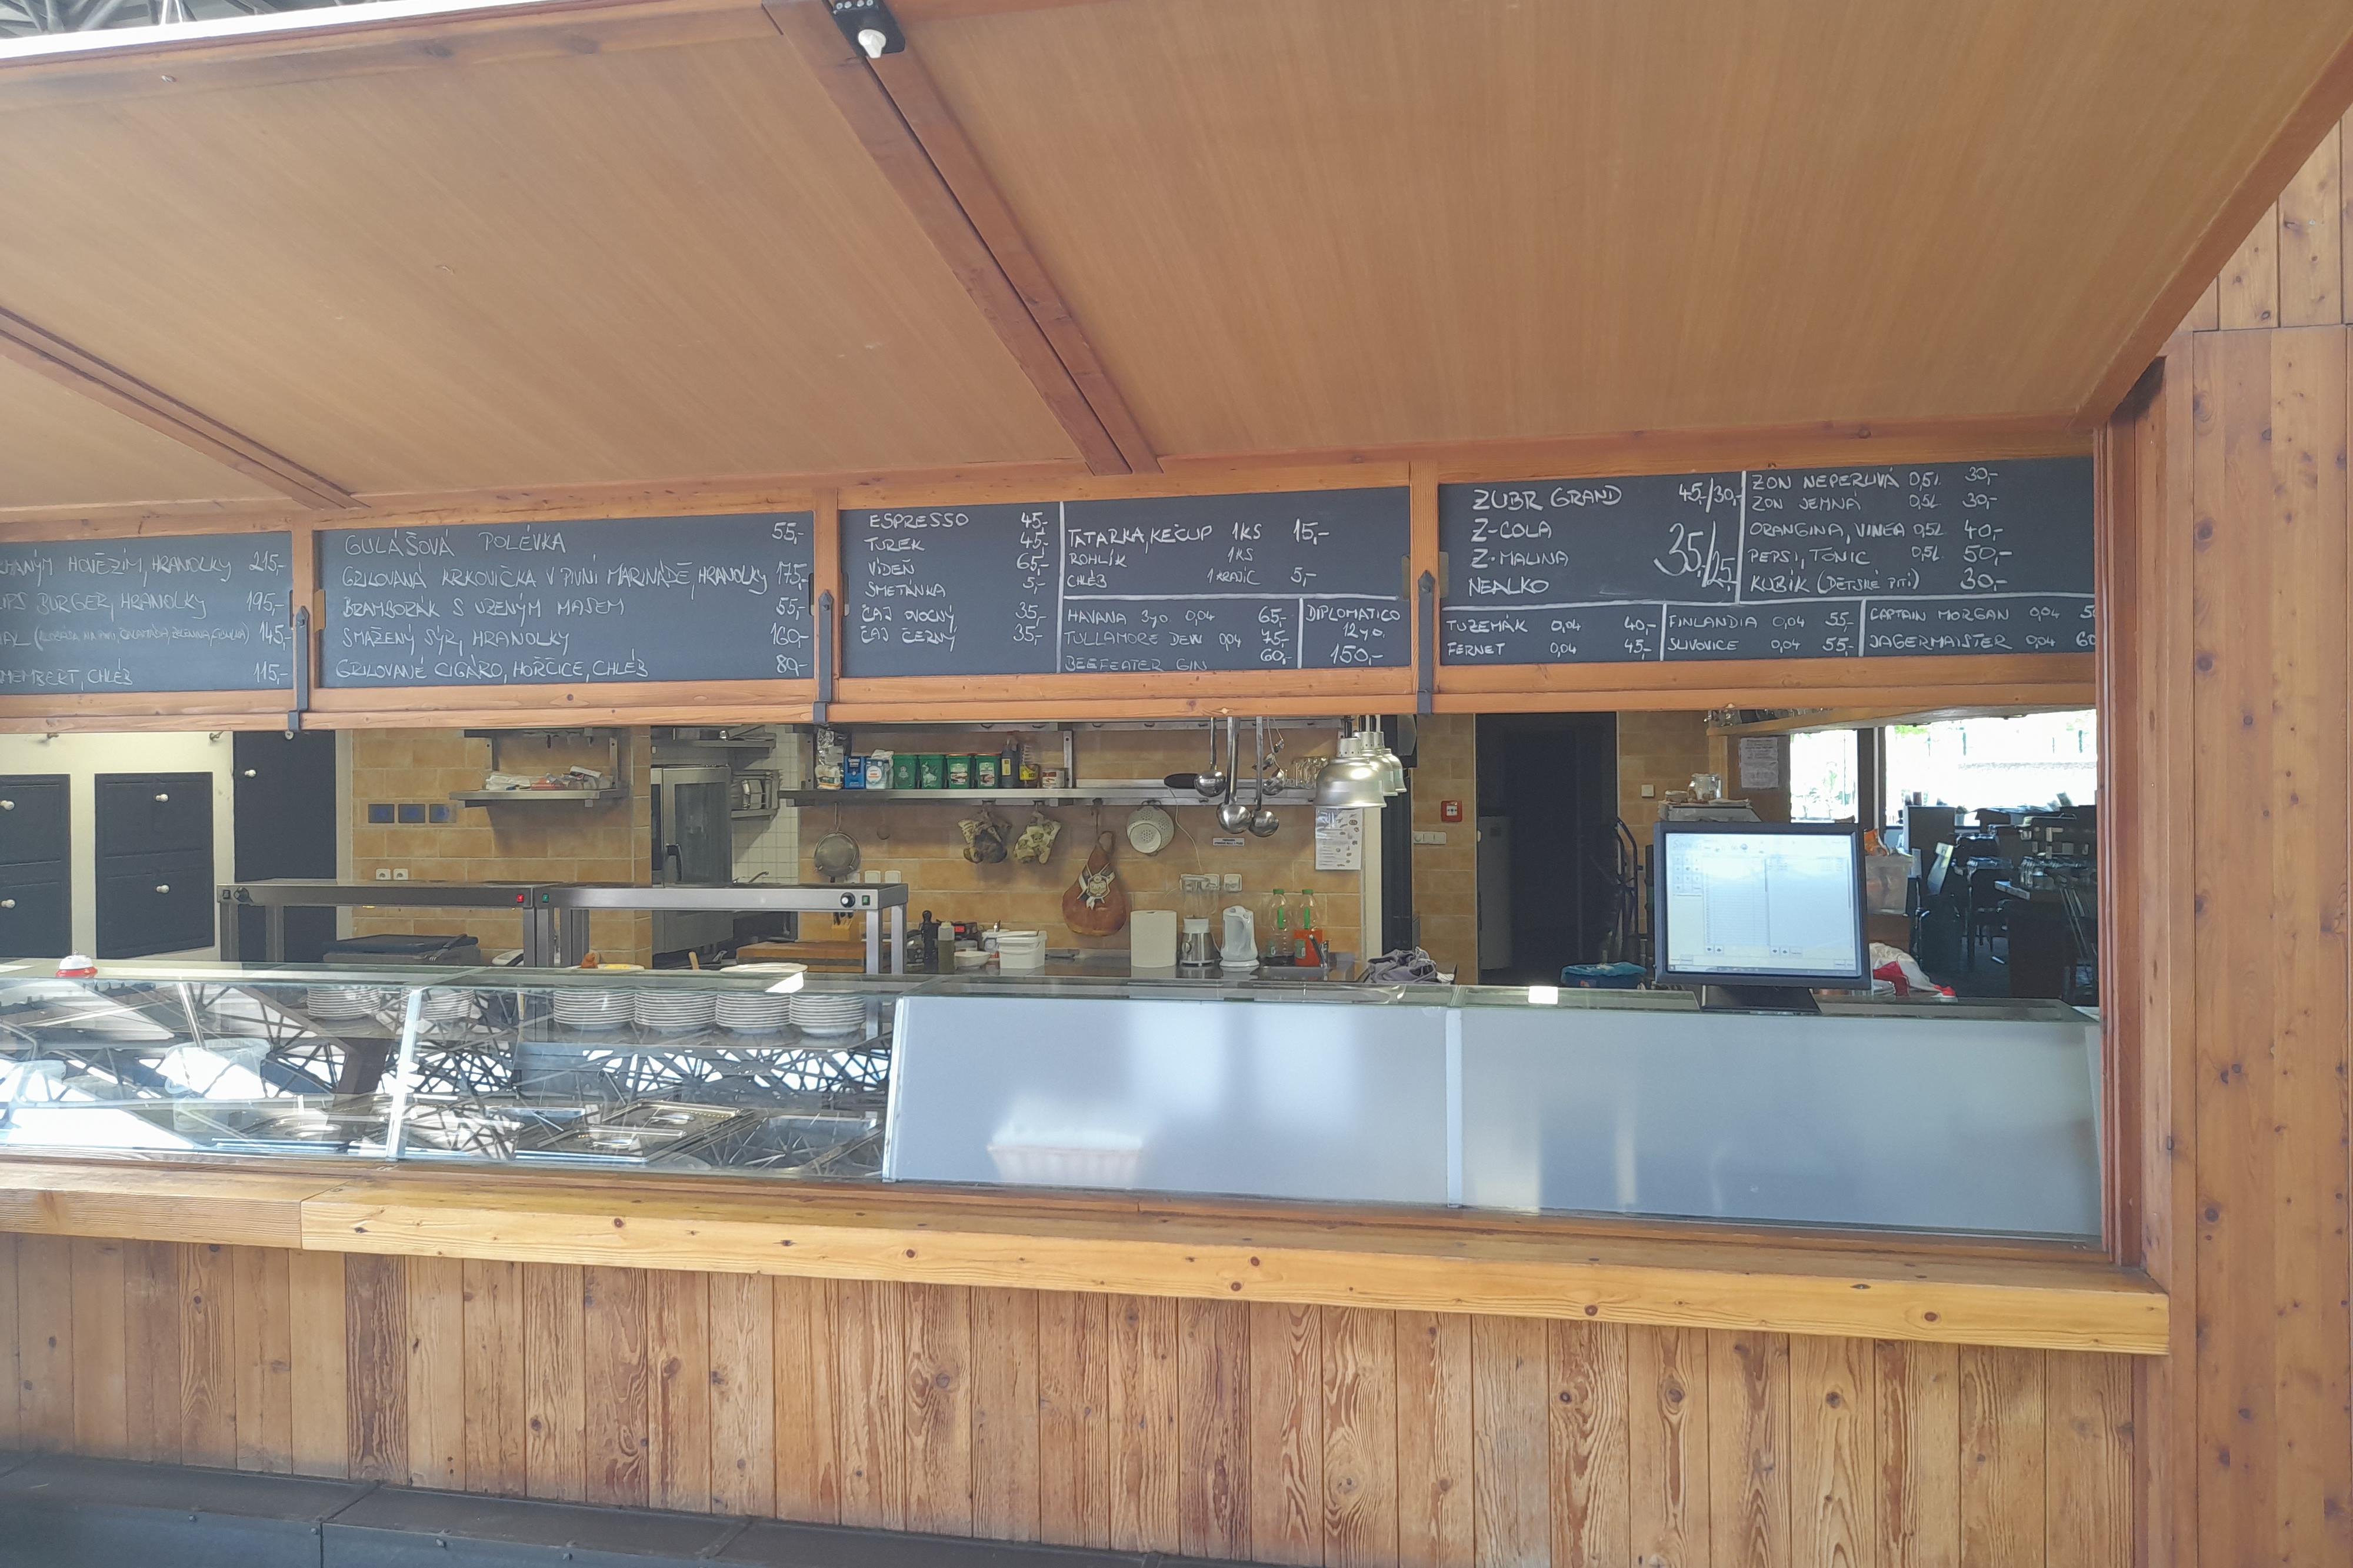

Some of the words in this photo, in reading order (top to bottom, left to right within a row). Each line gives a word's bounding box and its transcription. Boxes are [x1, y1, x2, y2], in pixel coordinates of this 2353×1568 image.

[1751, 473, 1792, 491] ZON
[1802, 466, 1901, 490] NEPERLIVÁ
[1964, 465, 1999, 487] 30,-
[1472, 489, 1544, 511] ZUBR
[1549, 484, 1622, 508] GRAND
[1750, 495, 1784, 512] ZON
[1798, 489, 1862, 512] JEMNÁ
[1961, 491, 1999, 511] 30,-
[869, 512, 970, 529] ESPRESSO
[1292, 518, 1331, 546] 15,-
[1471, 518, 1552, 542] Z-COLA
[1748, 521, 1852, 545] ORANGINA,
[1853, 521, 1906, 538] VINEA
[1963, 518, 2004, 542] 40,-
[345, 528, 455, 558] GULÁŠOVÁ
[478, 524, 566, 554] POLÉVKA
[772, 521, 805, 545] 55,-
[863, 536, 926, 552] TUREK
[152, 555, 232, 582] HRANOLKY
[249, 551, 286, 576] 215,-
[867, 556, 915, 576] VÍDEŇ
[1016, 552, 1050, 576] 65,-
[1068, 548, 1128, 568] ROHLÍK
[1746, 548, 1805, 571] PEPSI,
[1808, 546, 1872, 566] TONIC
[1962, 543, 2013, 566] 50,-
[342, 561, 427, 589] GRILOVANÁ
[441, 564, 537, 588] KRKOVIČKA
[546, 566, 555, 586] V
[560, 553, 598, 588] PIVNÍ
[698, 564, 768, 595] HRANOLKY
[776, 561, 809, 591] 175,-
[1066, 568, 1108, 589] CHLÉB
[1291, 566, 1317, 588] 5,-
[1749, 568, 1811, 593] KUBÍK
[1959, 566, 2008, 592] 30,-
[864, 578, 946, 598] SMETÁNKA
[1022, 576, 1046, 595] 5,-
[1468, 576, 1550, 597] NEALKO
[0, 591, 28, 612] IPS
[121, 590, 207, 619] HRANOLKY
[246, 590, 285, 616] 195,-
[452, 597, 464, 618] S
[474, 592, 542, 628] UZENÝM
[556, 597, 625, 616] MASEM
[775, 596, 806, 620] 55,-
[861, 603, 893, 622] ČAJ
[1015, 600, 1047, 627] 35,-
[1067, 608, 1128, 625] HAVANA
[1185, 609, 1216, 627] 0,04
[1258, 605, 1288, 628] 65,-
[1305, 604, 1401, 622] DIPLOMATICO
[1869, 606, 1927, 622] CAPTAIN
[1938, 606, 2010, 622] MORGAN
[2028, 606, 2061, 622] 0,04
[2079, 604, 2095, 619] 5
[1445, 613, 1529, 635] TUZEMÁK
[1550, 618, 1582, 635] 0,04
[1624, 615, 1657, 636] 40,-
[1668, 614, 1759, 629] FINLANDIA
[1771, 615, 1806, 631] 0,04
[1824, 610, 1855, 633] 55,-
[0, 631, 31, 648] AL
[259, 620, 292, 651] 145,-
[472, 629, 570, 657] HRANOLKY
[769, 622, 809, 649] 160,-
[859, 625, 889, 645] ČAJ
[901, 625, 958, 652] ČERNÝ
[1012, 623, 1043, 646] 35,-
[1064, 630, 1159, 646] TULLAMORE
[1168, 631, 1203, 647] DEW
[1667, 637, 1739, 652] SLIVOVICE
[1770, 638, 1802, 654] 0,04
[1821, 636, 1855, 658] 55,-
[2025, 634, 2057, 649] 0,04
[1065, 655, 1164, 672] BEEFEATER
[1176, 658, 1208, 672] GIN
[1260, 648, 1293, 665] 60,-
[1329, 643, 1384, 666] 150,-
[1447, 642, 1507, 657] FERNET
[1549, 642, 1578, 659] 0,04
[1624, 639, 1653, 661] 45,-
[254, 660, 289, 685] 115,-
[335, 654, 428, 680] GRILOVANÉ
[592, 648, 649, 678] CHLÉB
